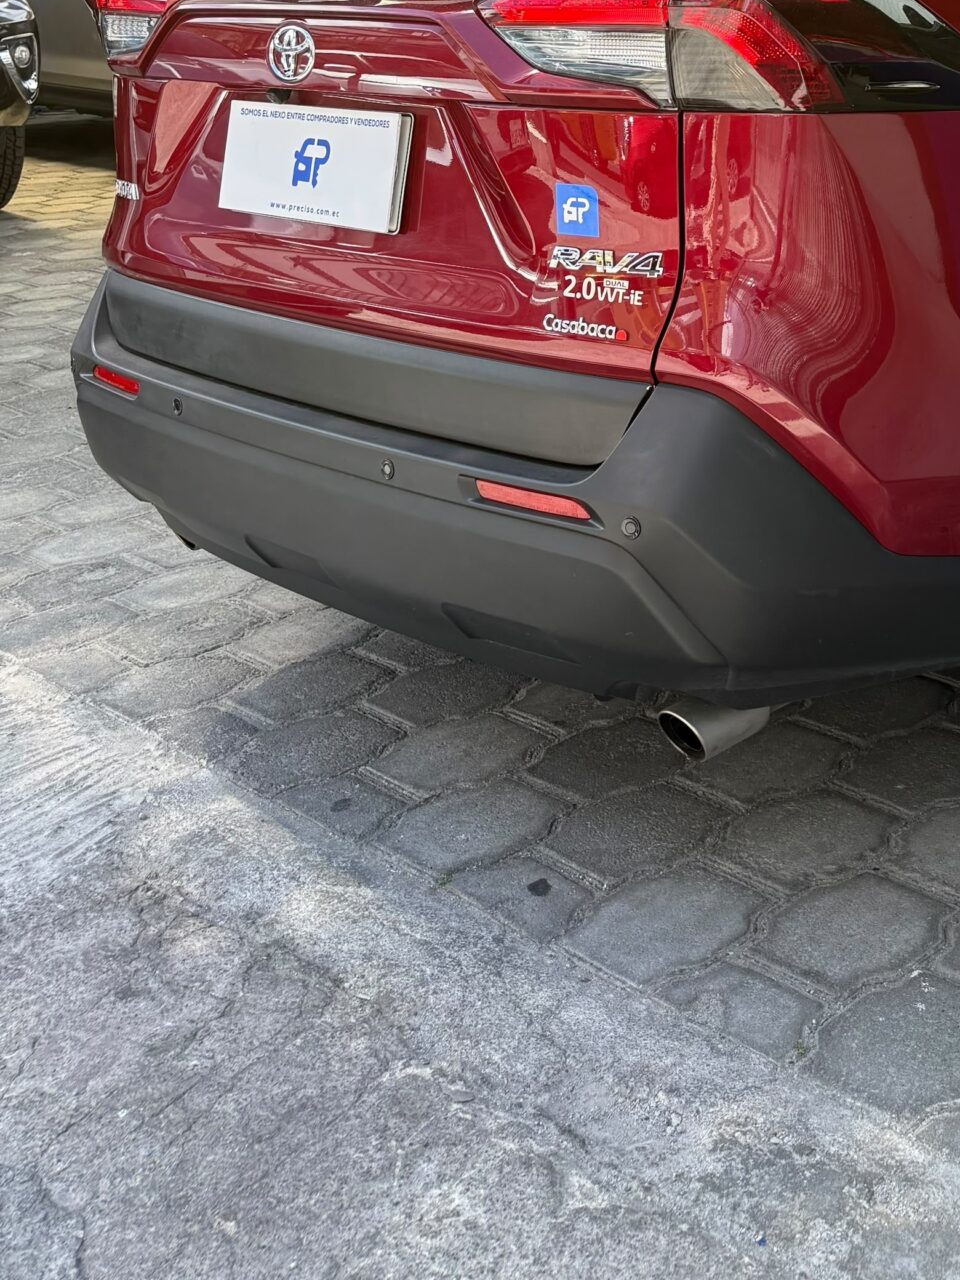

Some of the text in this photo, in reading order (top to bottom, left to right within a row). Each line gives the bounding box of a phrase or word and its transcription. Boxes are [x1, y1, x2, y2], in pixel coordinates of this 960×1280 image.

[240, 107, 262, 117] SOMOS
[262, 109, 269, 117] EL
[270, 111, 286, 119] NEXO
[286, 112, 306, 121] ENTRE
[306, 114, 349, 125] COMPRADORES
[354, 118, 390, 128] VENDEDORES
[270, 200, 340, 218] www.preciso.com.ec
[548, 246, 664, 278] RAV4
[563, 275, 596, 300] 2.0
[604, 279, 627, 288] DUAL
[543, 313, 617, 340] Casabaca
